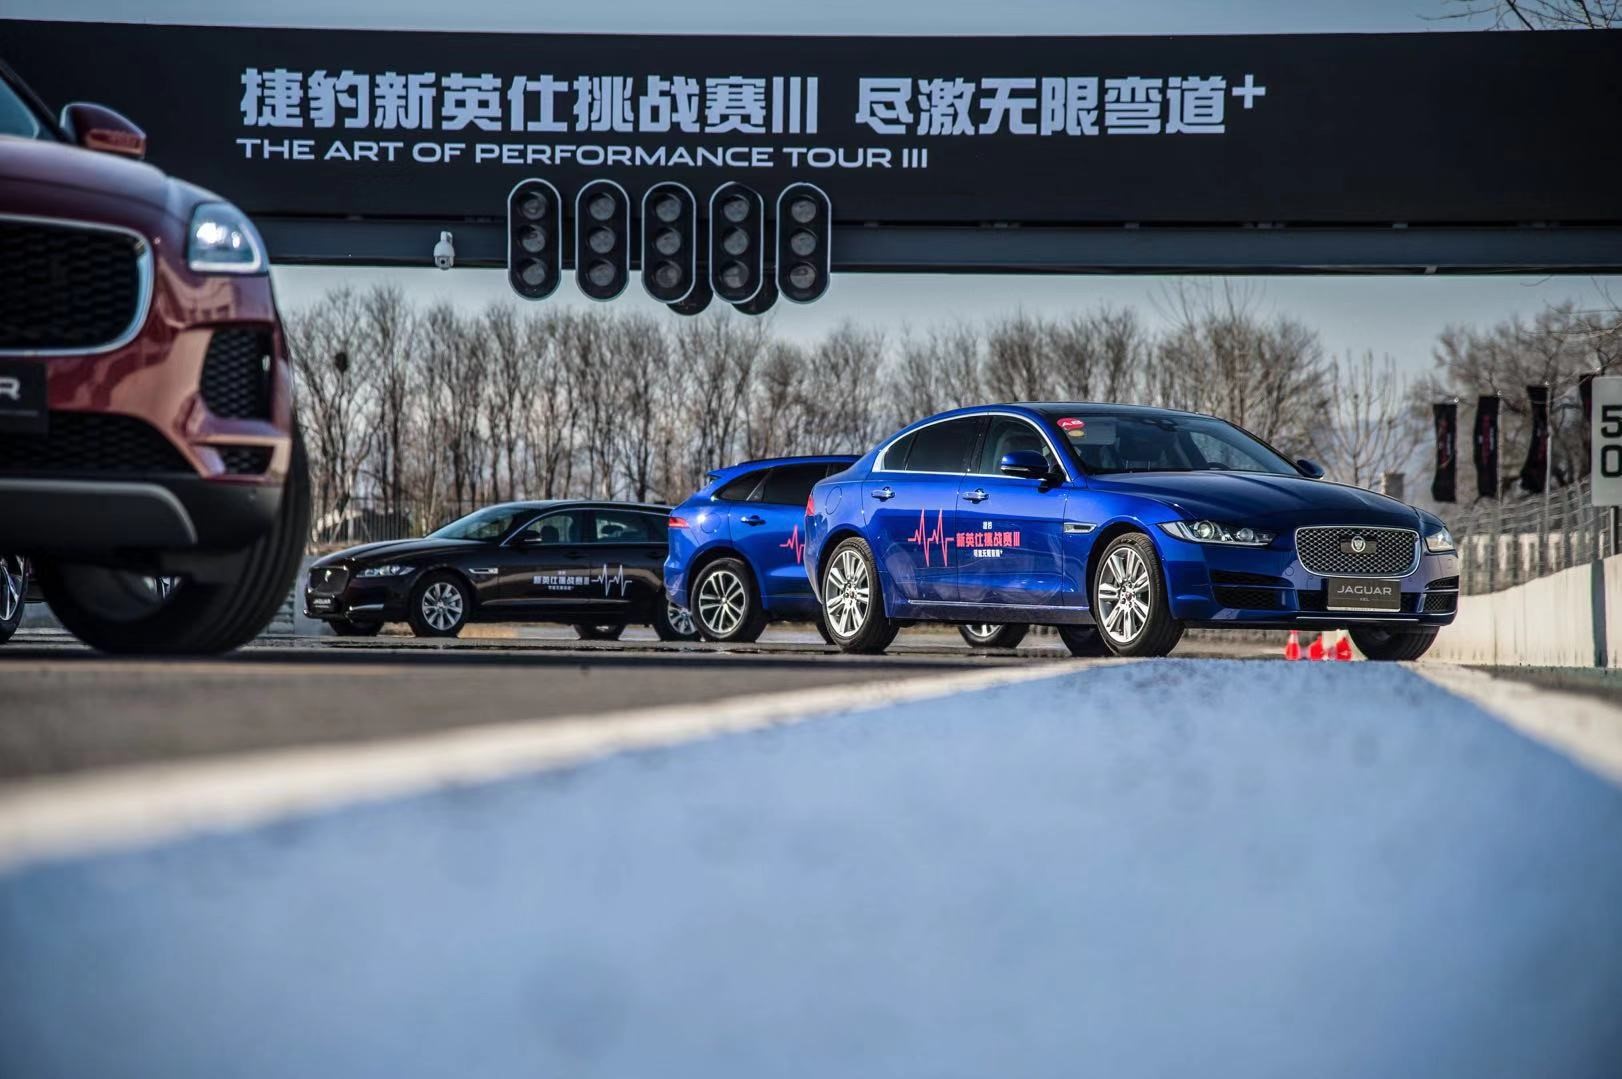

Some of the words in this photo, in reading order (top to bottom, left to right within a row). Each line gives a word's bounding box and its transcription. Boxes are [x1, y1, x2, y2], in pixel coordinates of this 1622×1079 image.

[236, 138, 315, 160] THE
[324, 140, 404, 162] ART
[412, 142, 466, 163] OF
[475, 143, 774, 168] PERFORMANCE
[783, 147, 892, 169] TOUR
[902, 148, 928, 169] III
[1336, 585, 1392, 596] JAGUAR
